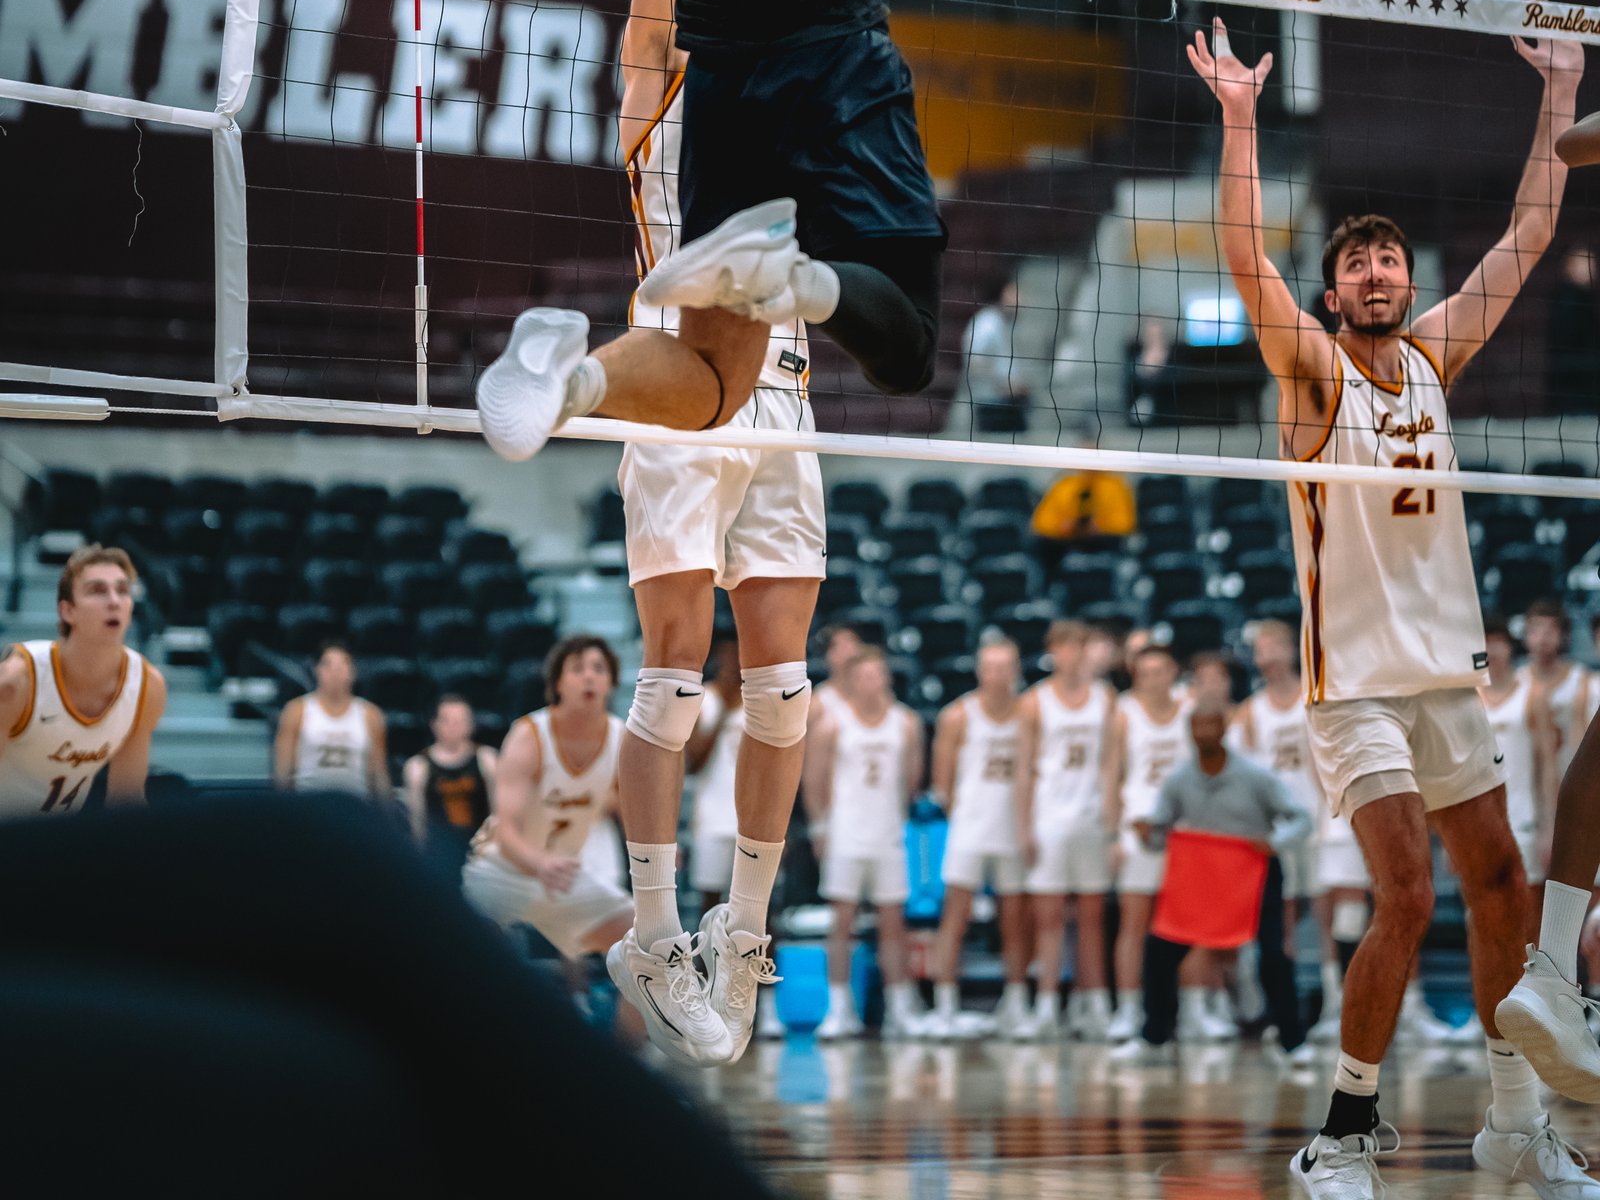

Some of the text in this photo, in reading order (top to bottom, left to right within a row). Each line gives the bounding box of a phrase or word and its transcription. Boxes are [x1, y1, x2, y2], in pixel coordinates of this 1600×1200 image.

[1375, 409, 1435, 443] Loyla
[1391, 452, 1435, 516] 21
[48, 741, 111, 767] Loyol
